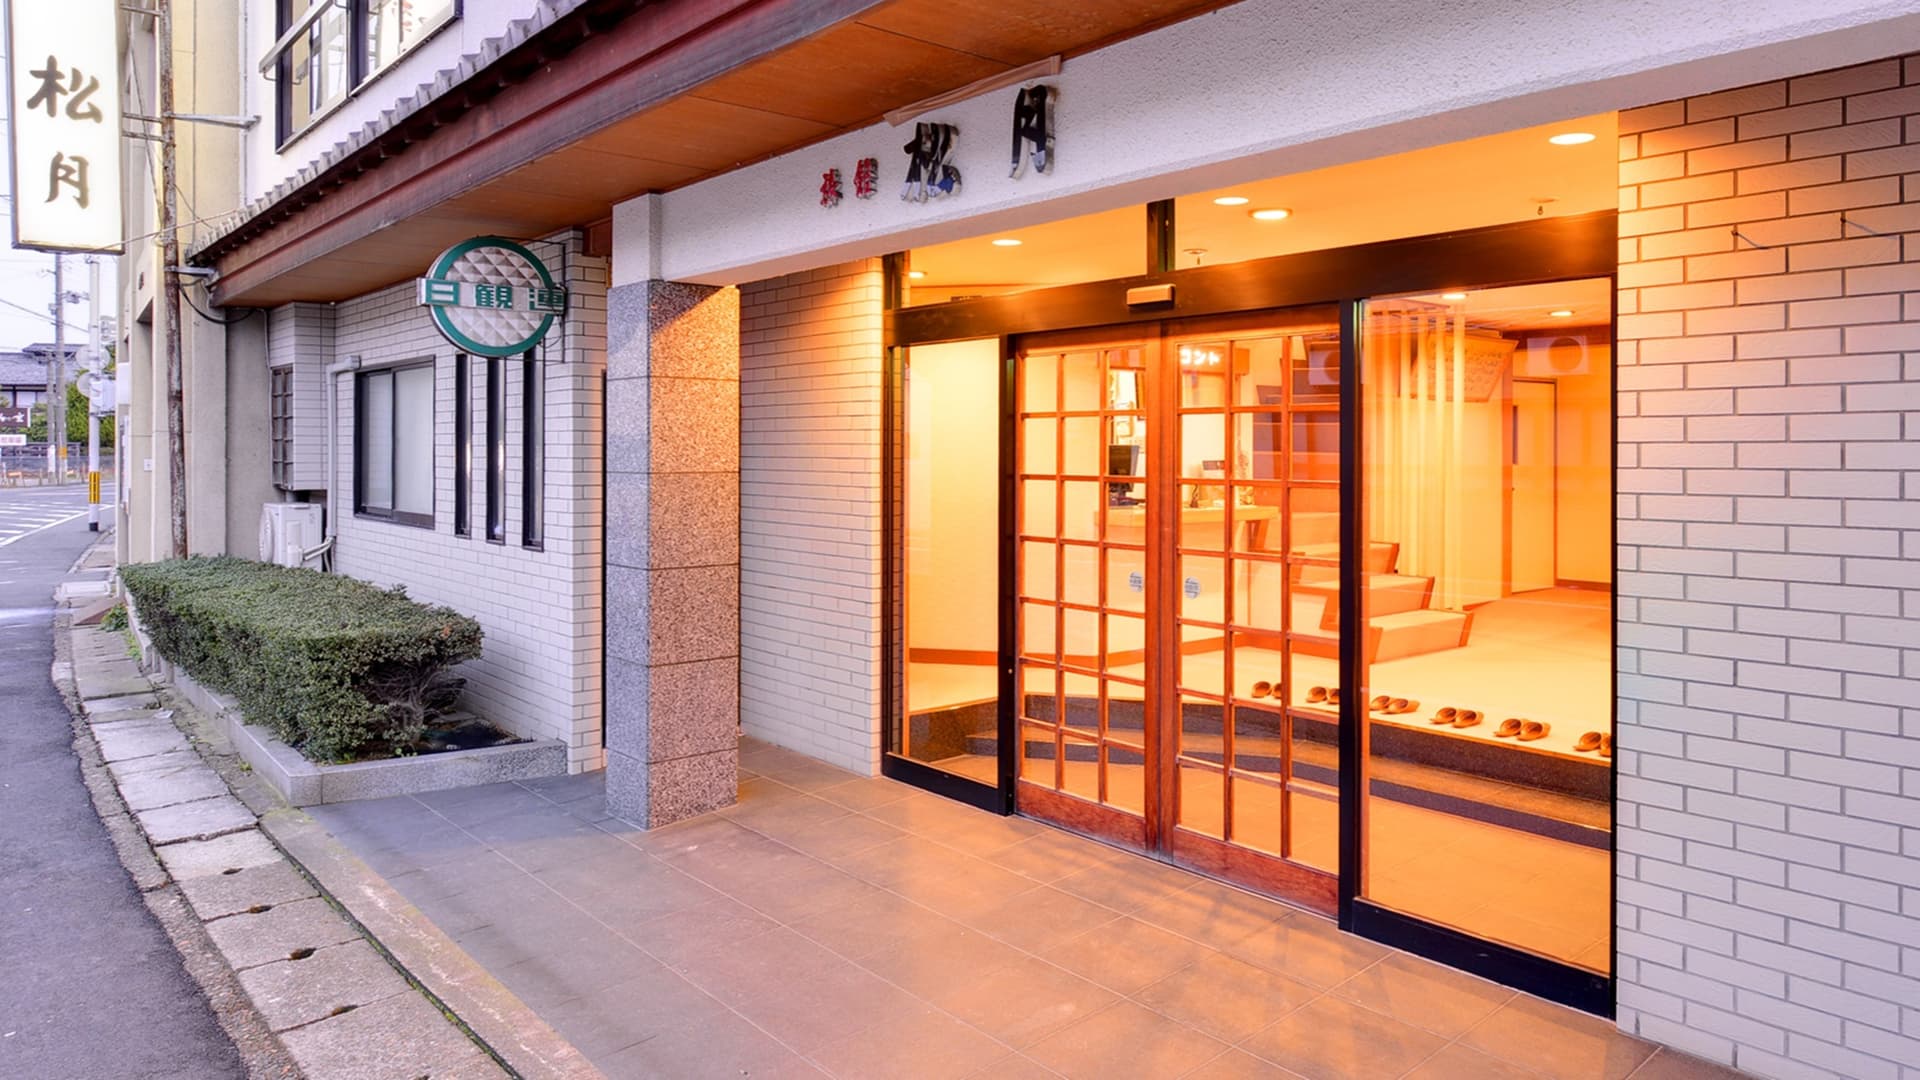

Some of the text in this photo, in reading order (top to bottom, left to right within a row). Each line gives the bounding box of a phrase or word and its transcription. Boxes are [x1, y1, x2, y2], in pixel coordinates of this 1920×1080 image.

[27, 55, 103, 209] 松月
[901, 84, 1058, 202] 松月
[425, 279, 565, 313] 日観連
